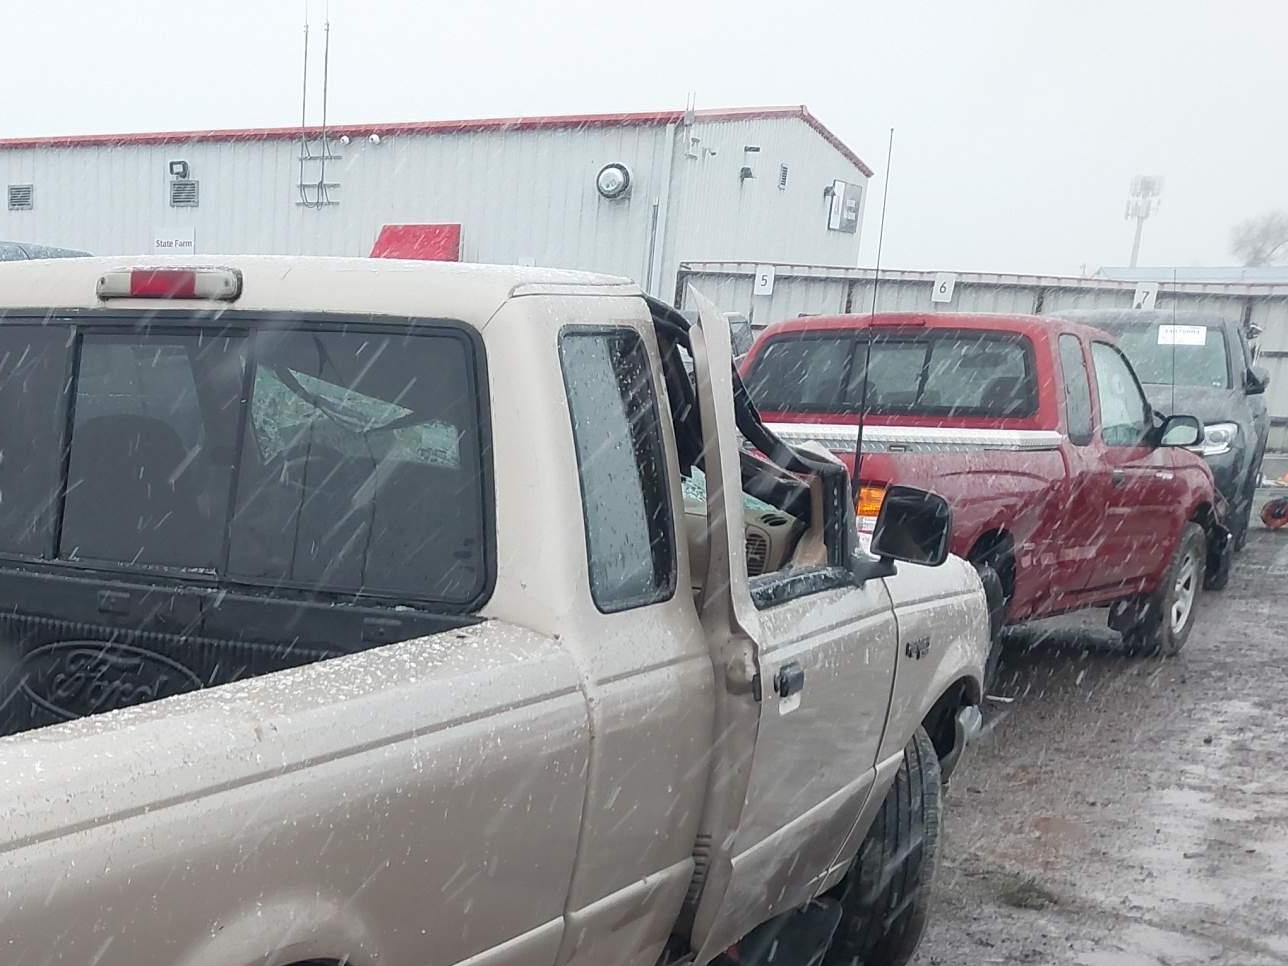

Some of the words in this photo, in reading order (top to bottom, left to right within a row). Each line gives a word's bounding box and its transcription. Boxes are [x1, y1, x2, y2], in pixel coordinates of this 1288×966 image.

[155, 239, 174, 248] State
[174, 239, 192, 247] Farm
[761, 274, 768, 286] 5
[939, 281, 947, 294] 6
[1142, 291, 1149, 304] 7
